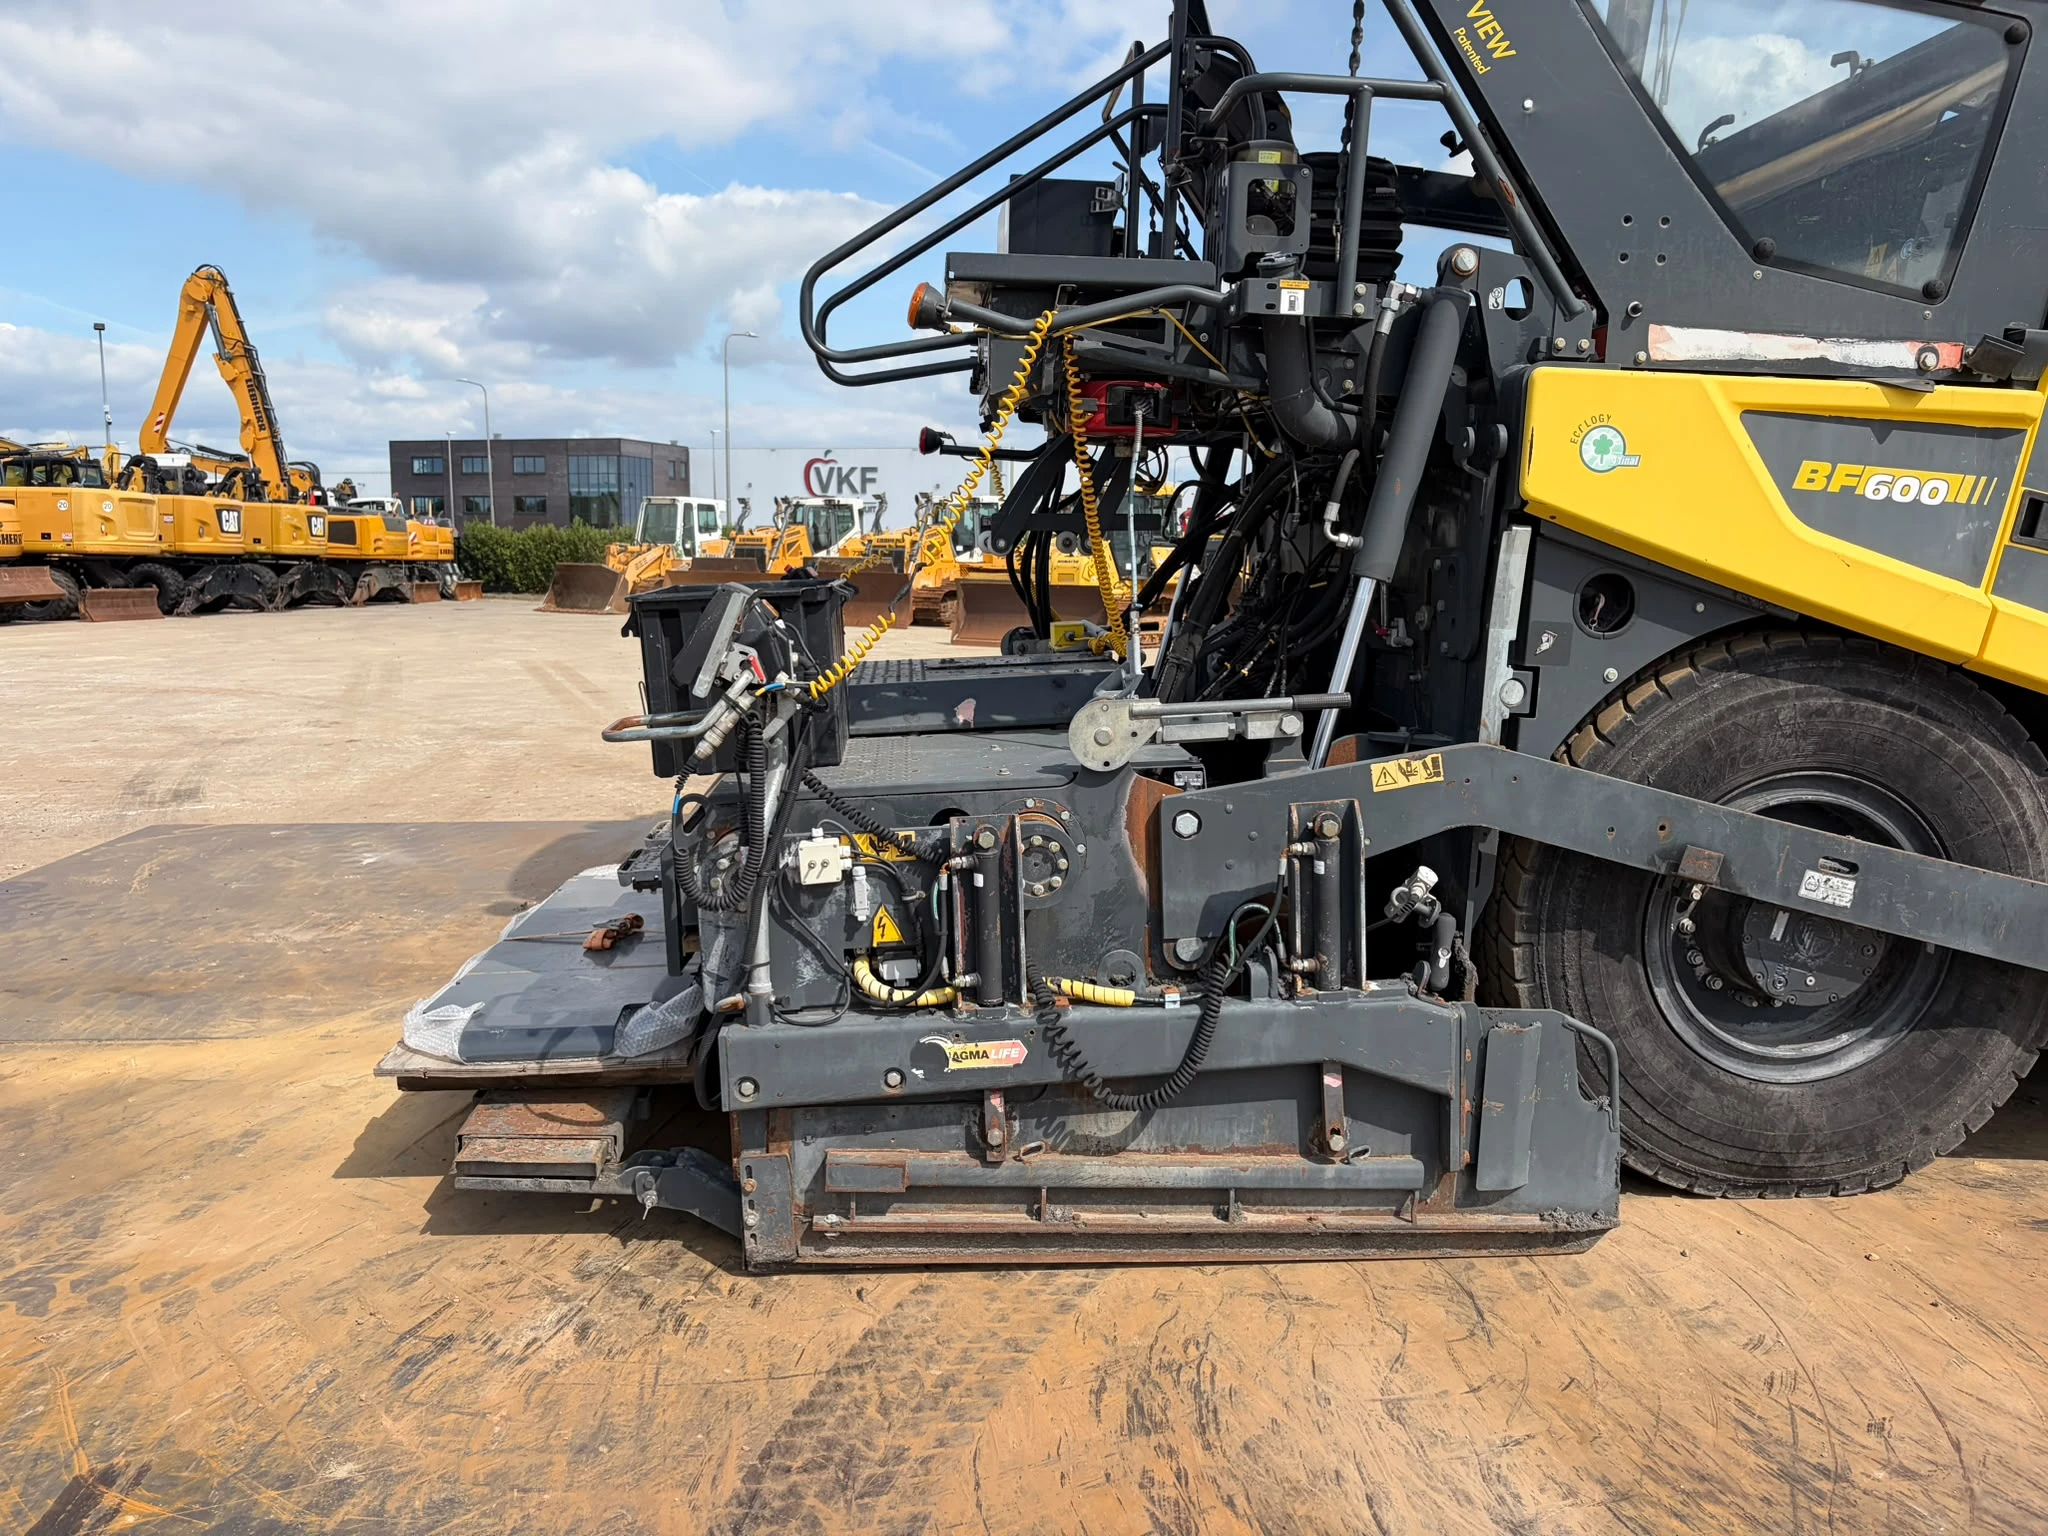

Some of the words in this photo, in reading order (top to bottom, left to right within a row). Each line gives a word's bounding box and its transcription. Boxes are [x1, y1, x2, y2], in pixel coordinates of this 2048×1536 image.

[1466, 0, 1517, 58] VIEW
[1453, 27, 1491, 74] Patented
[245, 378, 266, 432] LIEBHERR
[813, 466, 878, 495] VKF
[221, 511, 239, 532] CAT
[311, 517, 324, 536] CAT
